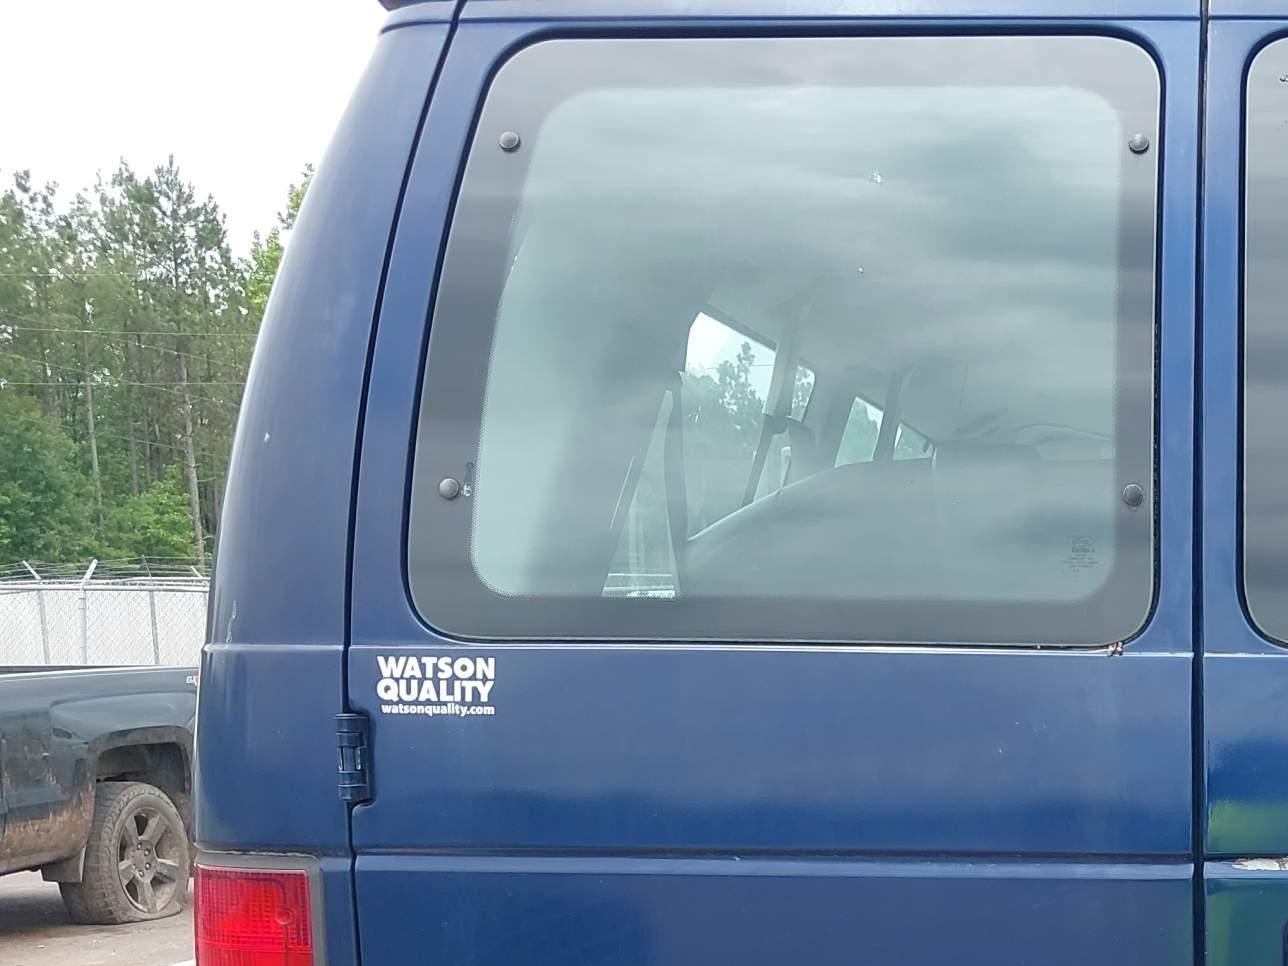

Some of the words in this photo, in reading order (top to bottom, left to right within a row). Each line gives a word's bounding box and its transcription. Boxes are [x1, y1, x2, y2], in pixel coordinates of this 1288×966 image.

[376, 655, 496, 679] WATSON
[376, 678, 495, 702] QUALITY
[381, 703, 496, 716] watsonquality.com
